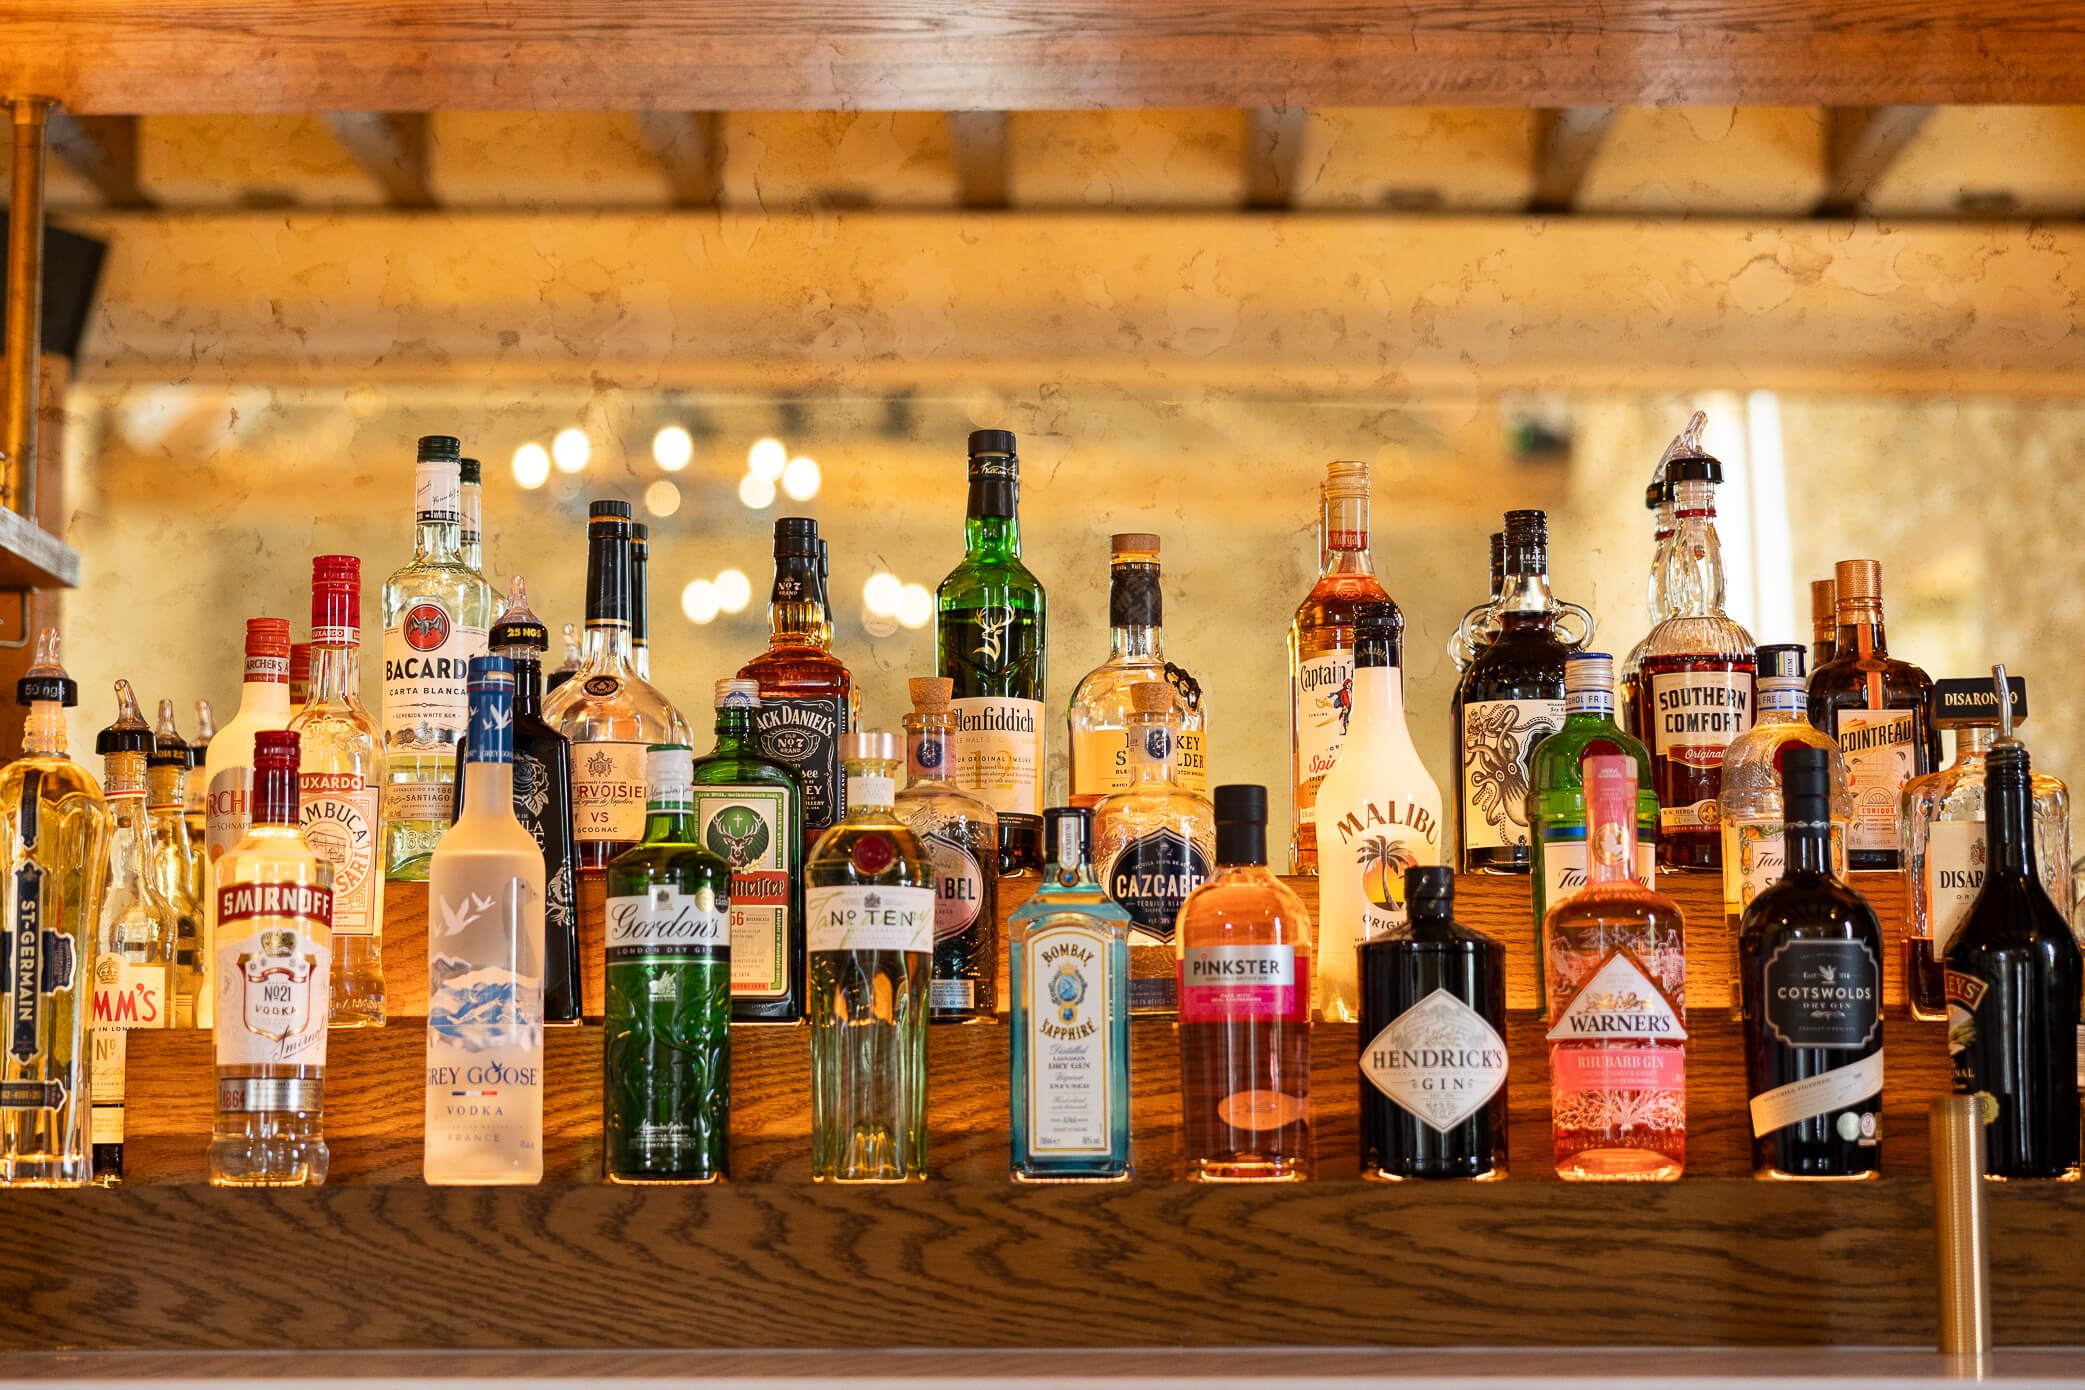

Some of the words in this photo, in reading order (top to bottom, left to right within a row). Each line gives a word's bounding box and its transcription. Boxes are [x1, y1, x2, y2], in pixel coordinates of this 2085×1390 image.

[507, 628, 521, 637] 25
[523, 628, 542, 638] NGS
[386, 657, 467, 681] BACARD
[1300, 660, 1346, 692] Captain
[389, 688, 418, 697] CARTA
[1659, 687, 1747, 711] SOUTHERN
[1944, 691, 2018, 706] DISARONO
[756, 710, 780, 732] ACK
[782, 705, 836, 738] DANIEL'S
[1665, 712, 1743, 733] COMFORT
[796, 738, 805, 747] 7
[1840, 720, 1911, 753] COINTREAU
[1685, 749, 1725, 761] Original
[970, 750, 1015, 789] 12
[300, 775, 363, 790] UXARDO
[406, 794, 450, 802] SANTIAGO
[300, 802, 367, 842] AMBUCA
[591, 811, 609, 823] VS
[1336, 800, 1439, 845] MALIBU
[223, 886, 329, 917] SMIRNOFF
[611, 903, 719, 940] Gordon's
[864, 910, 913, 926] TEN
[18, 900, 36, 1021] ST-GERMAIN
[617, 947, 660, 955] LONDON
[1041, 943, 1095, 967] BOMBAY
[1193, 954, 1280, 976] PINKSTER
[92, 983, 157, 1022] MM'S
[1777, 987, 1871, 999] COTSWOLDS
[255, 1004, 296, 1015] VODKA
[1039, 1017, 1098, 1041] SAPPHIRE
[1569, 1014, 1670, 1032] WARNER'S
[1373, 1049, 1502, 1068] HENDRICK'S
[1577, 1055, 1641, 1068] RHUBARB
[1642, 1055, 1665, 1068] GIN
[467, 1065, 537, 1086] GOOSE
[1422, 1077, 1464, 1090] GIN
[222, 1089, 246, 1109] 1864
[447, 1105, 504, 1116] VODKA
